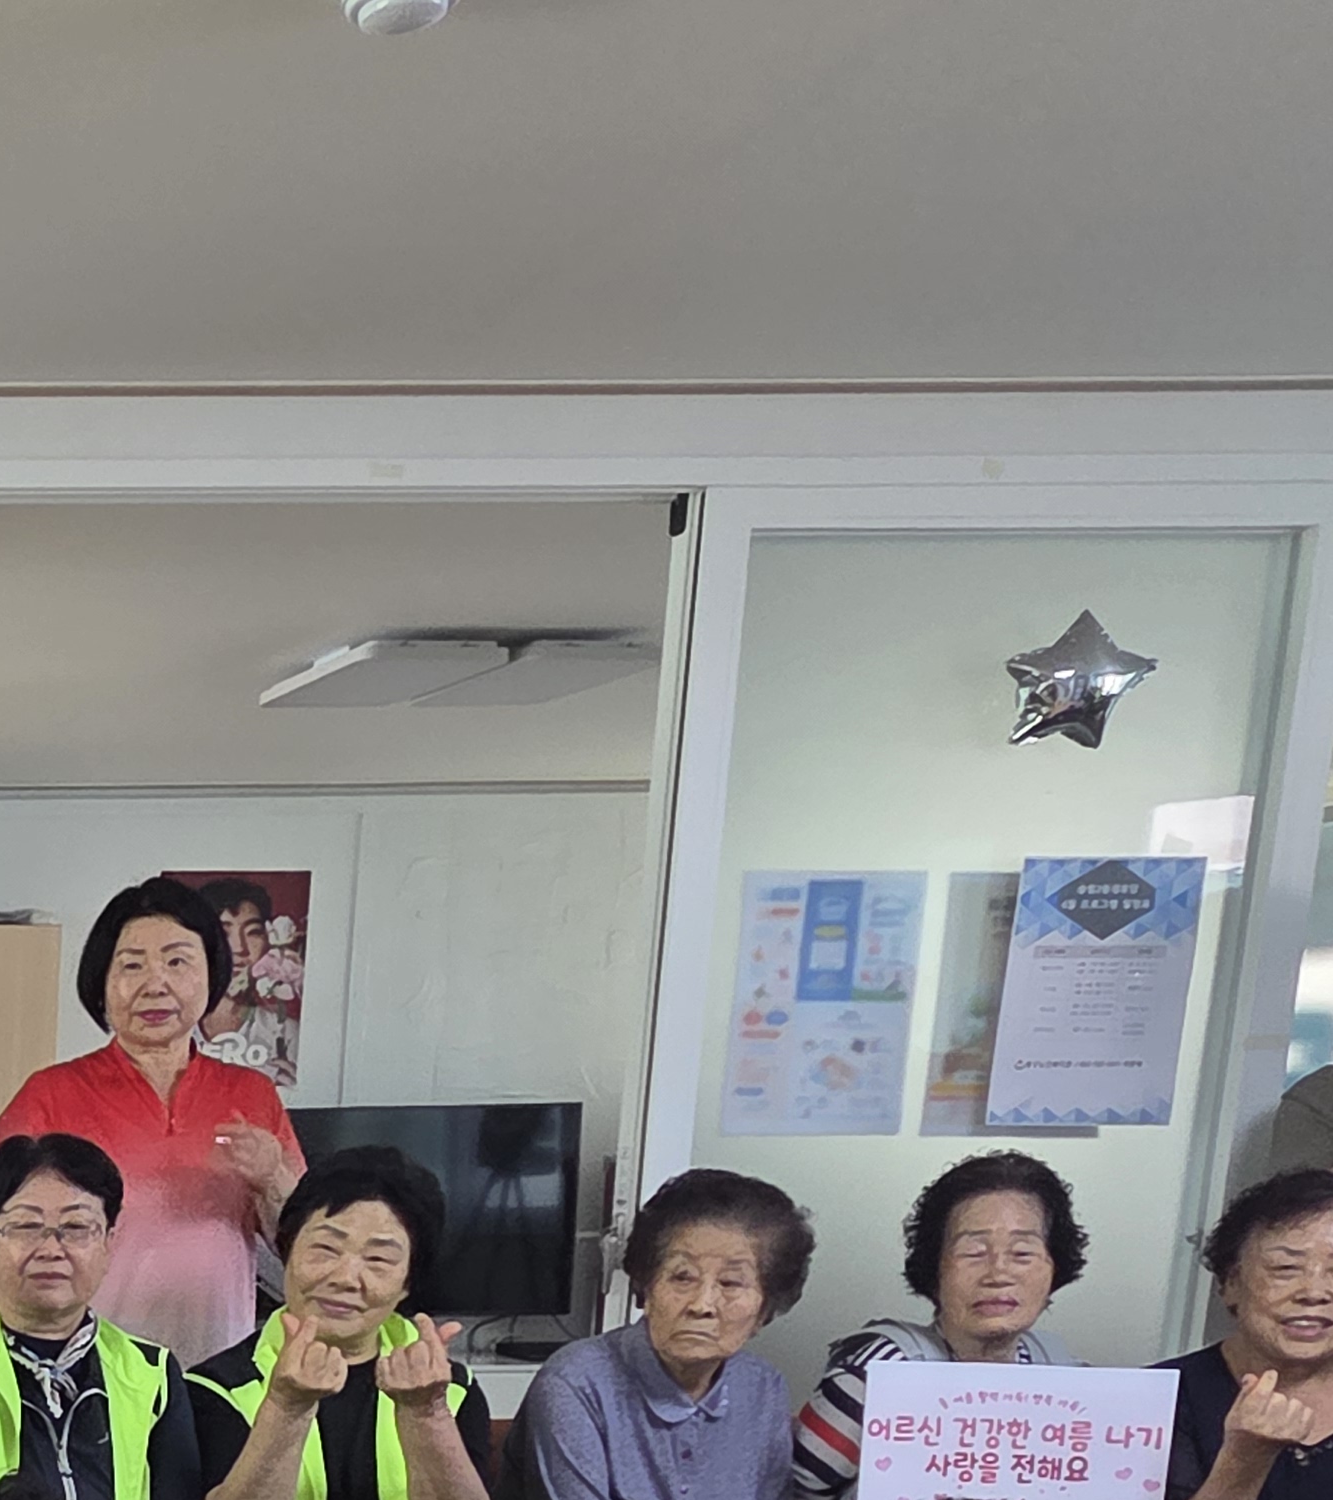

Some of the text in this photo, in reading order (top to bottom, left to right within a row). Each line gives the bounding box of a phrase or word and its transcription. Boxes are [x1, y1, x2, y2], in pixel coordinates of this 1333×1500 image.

[867, 1415, 1163, 1453] 어르신 건강한 여름 나기
[925, 1452, 1089, 1484] 사랑을 전해요
